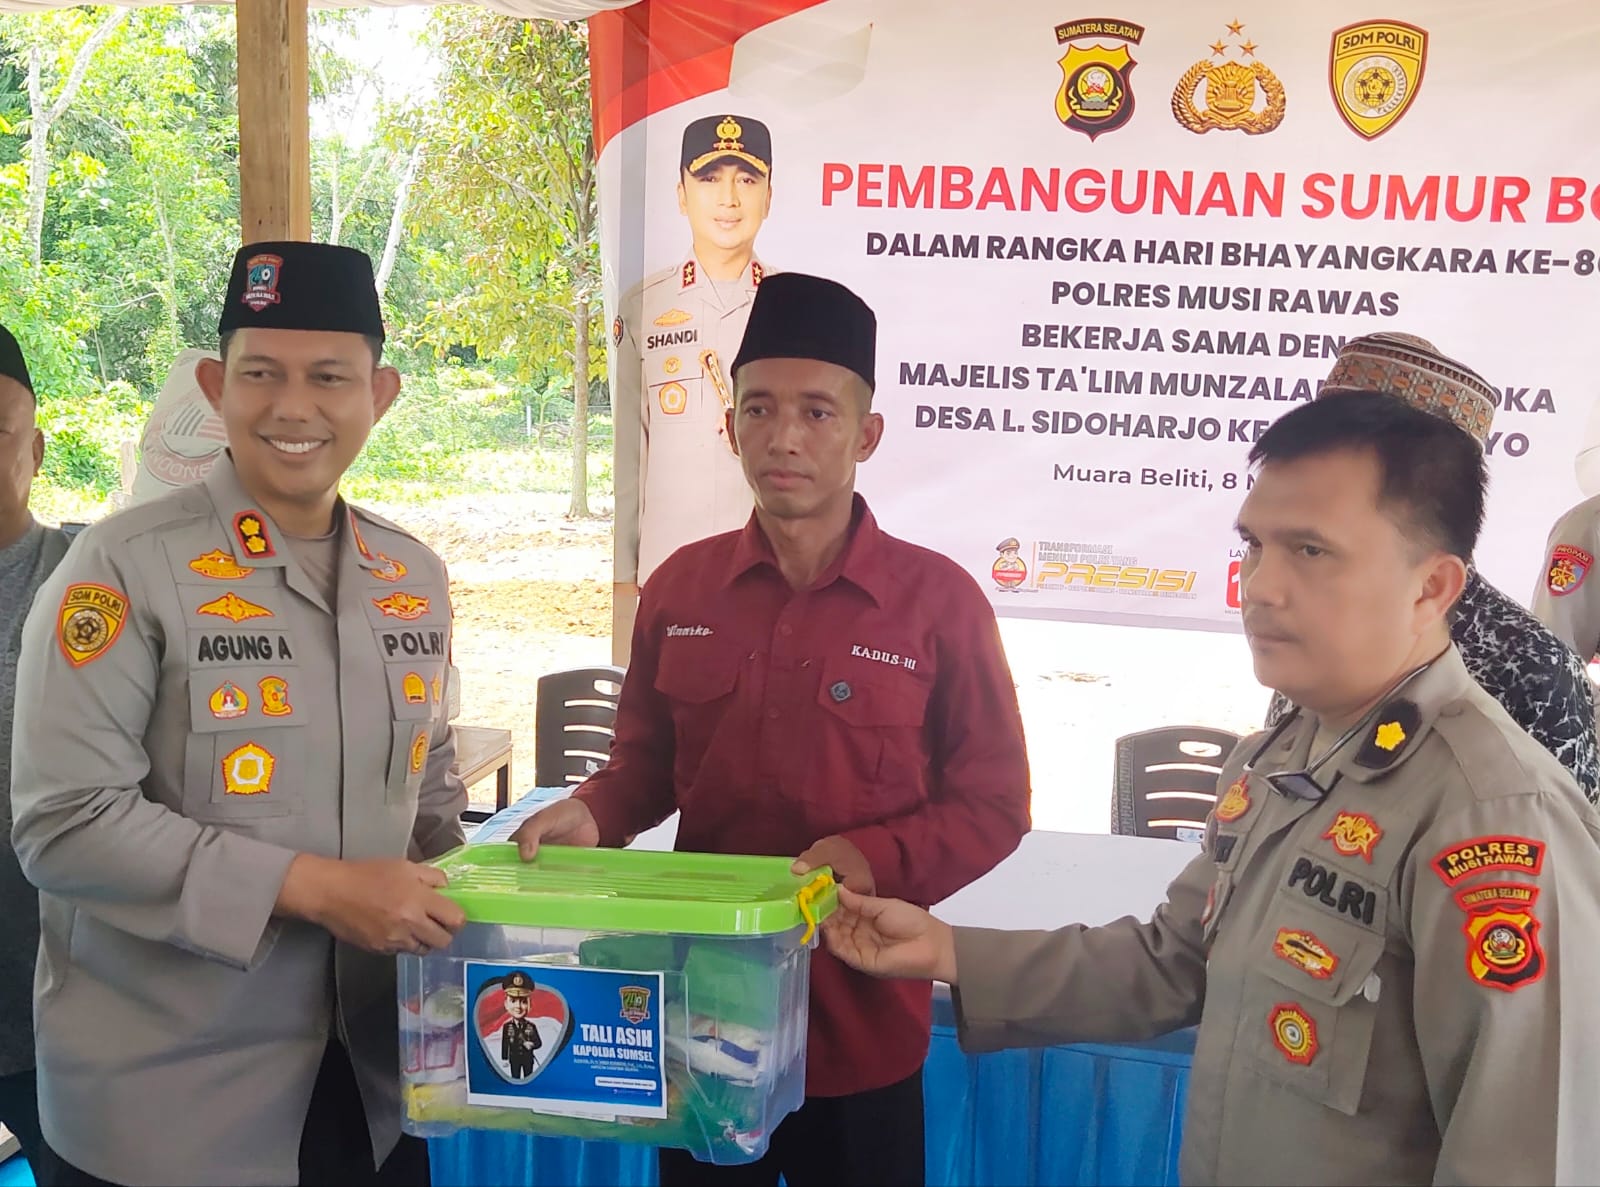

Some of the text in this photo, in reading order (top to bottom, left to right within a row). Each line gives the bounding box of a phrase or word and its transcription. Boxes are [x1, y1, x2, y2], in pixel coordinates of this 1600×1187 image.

[1057, 23, 1140, 40] SUMATERA SELATAN
[1342, 32, 1415, 50] SDM POLRI
[822, 162, 1600, 224] PEMBANGUNAN SUMUR B
[866, 232, 1600, 277] DALAM RANGKA HARI BHAYANGKARA KE-8
[1052, 281, 1400, 316] POLRES MUSI RAWAS
[647, 329, 698, 349] SHANDI
[1021, 324, 1346, 359] BEKERJA SAMA DEN
[899, 362, 1557, 414] MAJELIS TA'LIM MUNZALA KA
[915, 405, 1530, 457] DESA L. SIDOHARJO KE YO
[1053, 463, 1132, 484] Muara
[1140, 467, 1214, 491] Beliti,
[1221, 472, 1238, 490] 8
[1036, 561, 1198, 593] PRESISI
[70, 590, 122, 612] SDM POLRI
[198, 634, 292, 662] AGUNG A
[382, 631, 445, 657] POLRI
[1446, 842, 1530, 866] POLRES
[1447, 854, 1534, 878] MUSI RAWAS
[1287, 856, 1377, 926] POLRI
[580, 1023, 653, 1048] TALI ASIH
[572, 1044, 654, 1062] KAPOLDA SUMSEL
